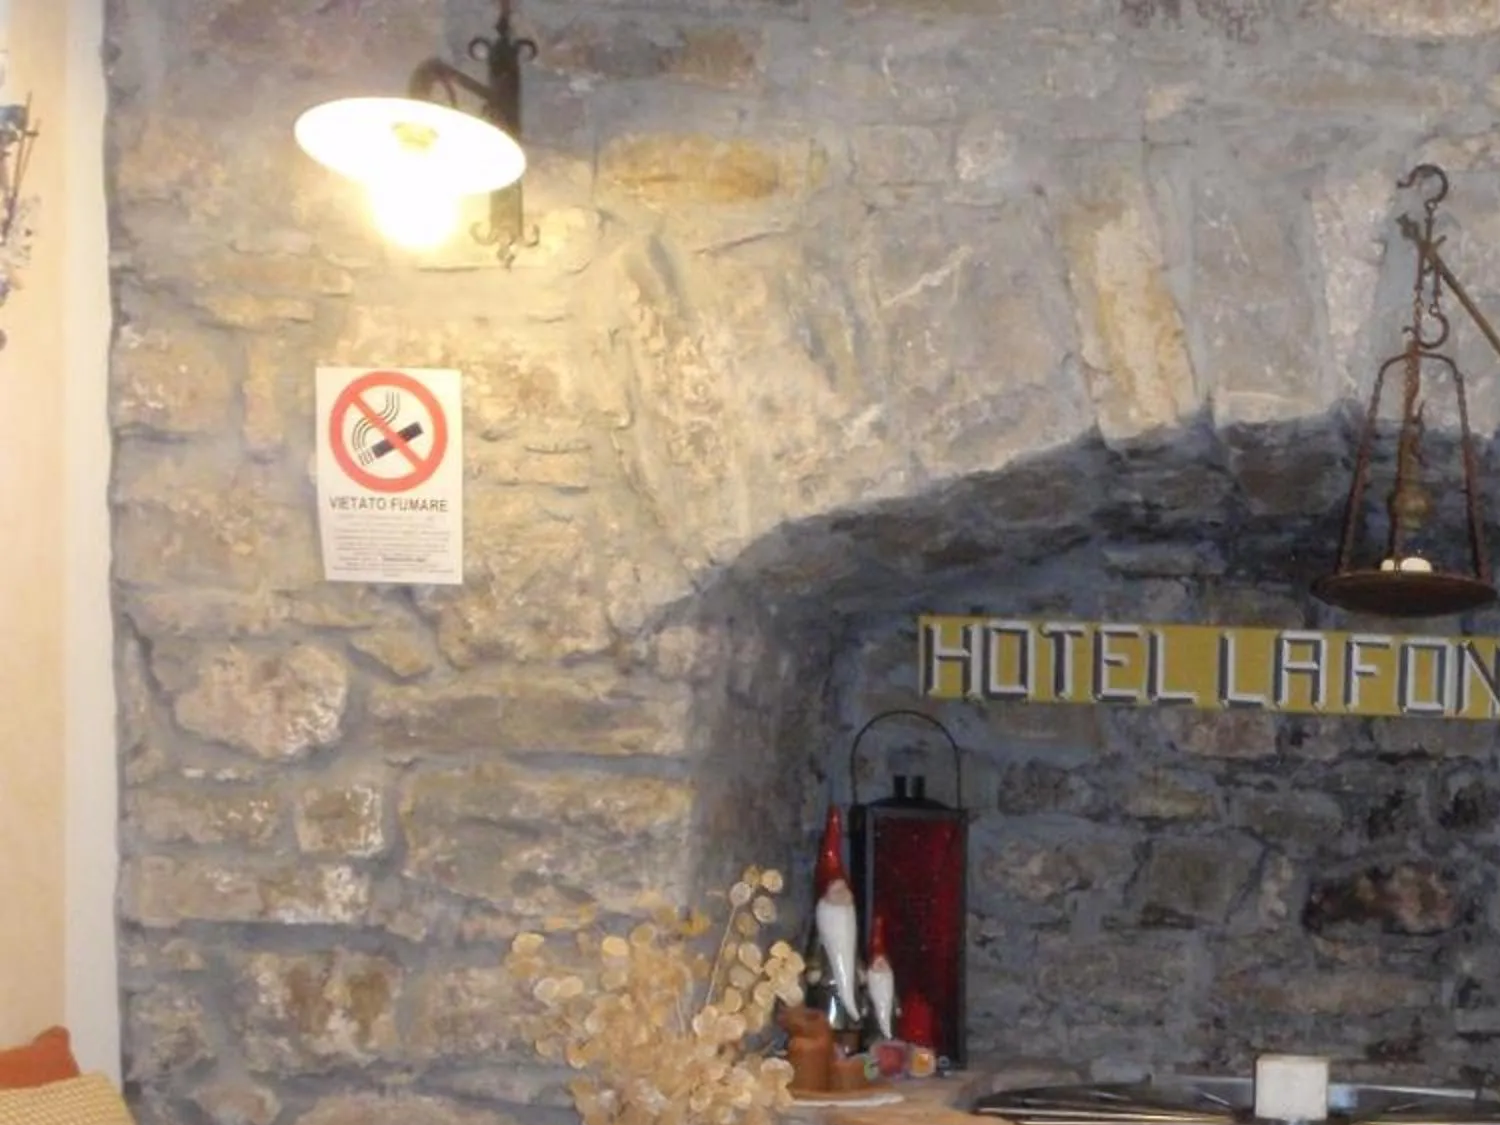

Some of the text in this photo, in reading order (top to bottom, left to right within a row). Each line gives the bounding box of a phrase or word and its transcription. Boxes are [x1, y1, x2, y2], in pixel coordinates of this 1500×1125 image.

[329, 496, 448, 512] VIETATO FUMARE
[925, 621, 1199, 704] HOTEL
